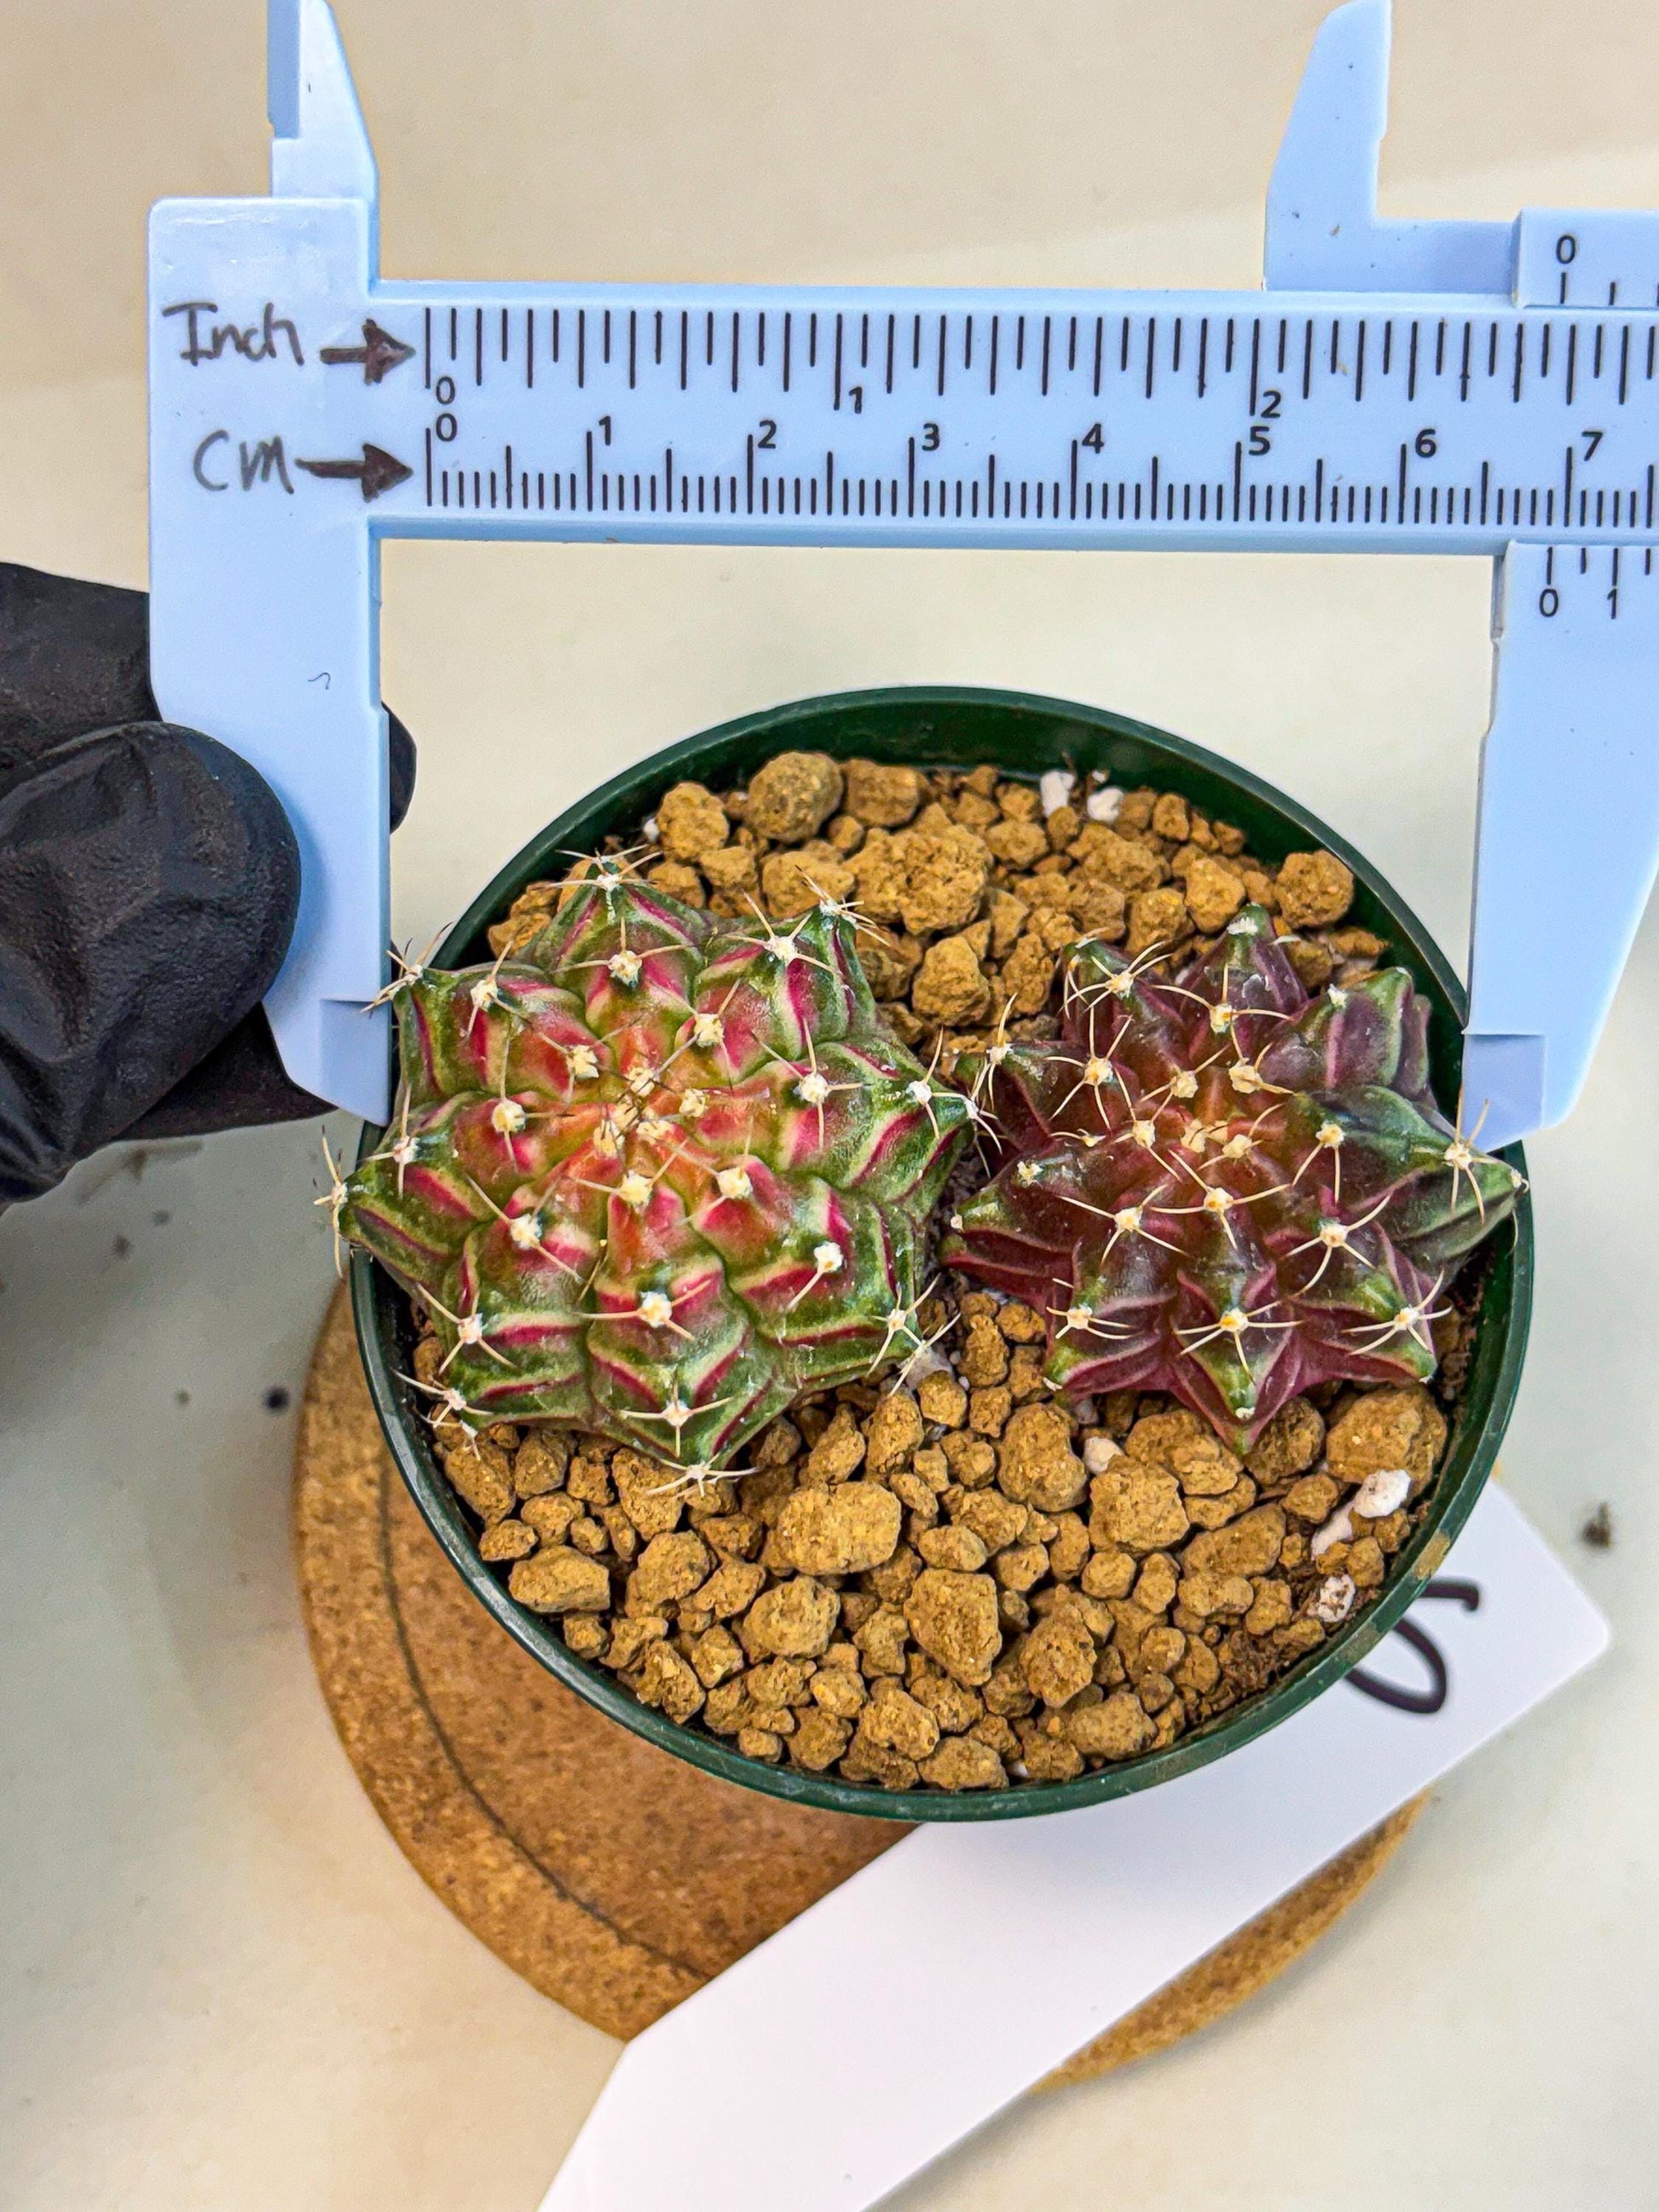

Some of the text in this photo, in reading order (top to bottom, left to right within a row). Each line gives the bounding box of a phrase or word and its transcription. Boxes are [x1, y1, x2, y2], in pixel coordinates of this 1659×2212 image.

[1556, 234, 1577, 264] 0
[162, 302, 305, 366] Inch
[436, 376, 1281, 419] 0 1 2
[436, 413, 1604, 461] 0 1 2 3 4 5 6 7
[1539, 588, 1619, 619] 0 1
